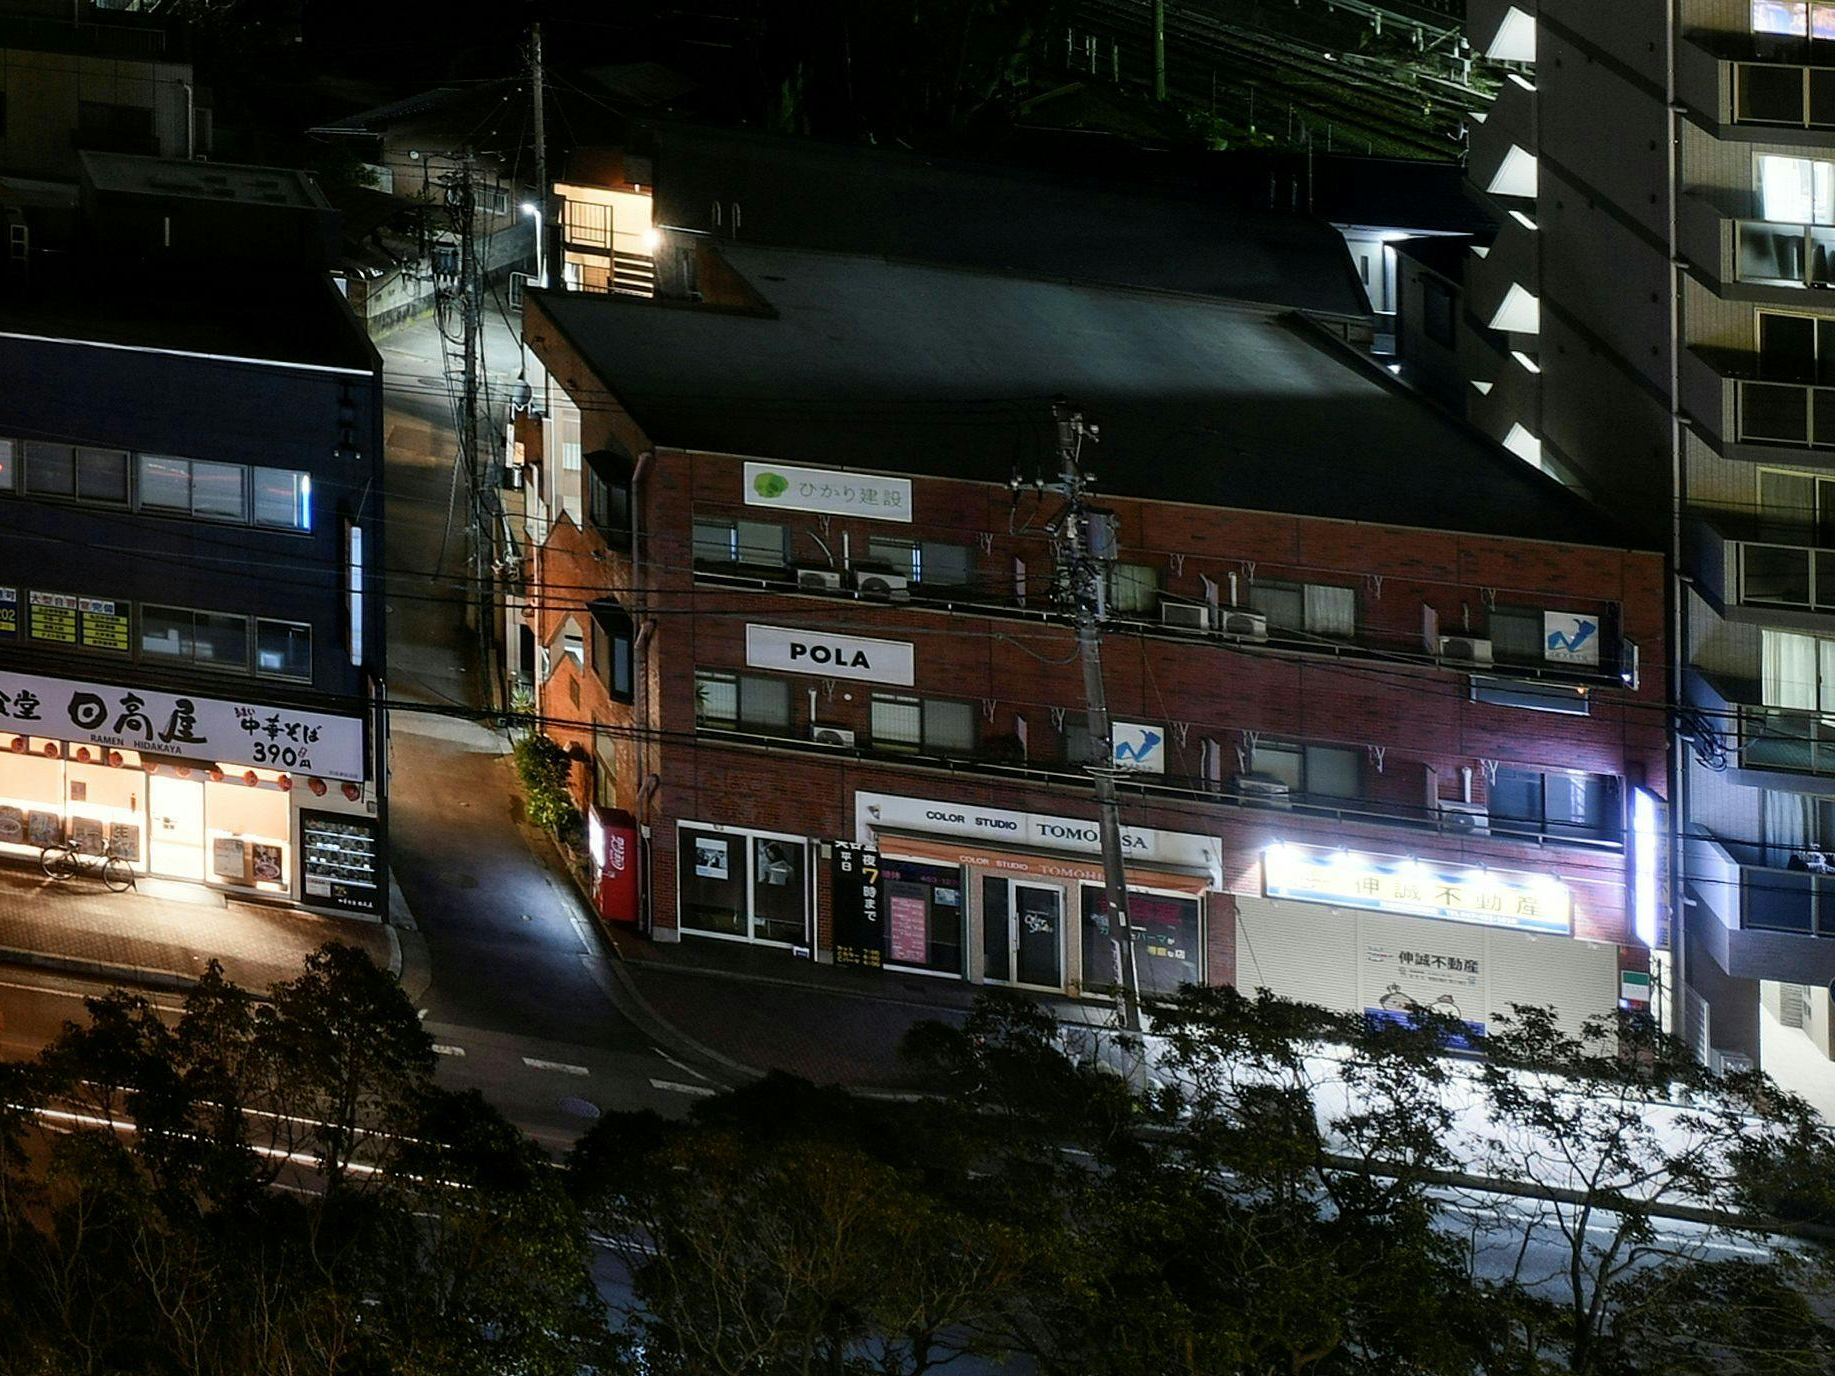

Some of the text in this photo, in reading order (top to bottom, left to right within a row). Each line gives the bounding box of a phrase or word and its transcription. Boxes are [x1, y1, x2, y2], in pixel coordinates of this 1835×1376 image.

[799, 482, 902, 508] ひかり建設
[790, 643, 870, 669] POLA
[68, 691, 207, 744] 日高屋
[241, 714, 322, 743] 中華そば
[90, 733, 182, 755] RAMEN HIDAKAYA
[253, 741, 312, 770] 390円
[926, 810, 1148, 850] COLOR STUDIO TOMOSA
[959, 855, 989, 866] COLOR
[996, 860, 1029, 871] STUDIO
[1398, 951, 1479, 974] 伸誠不動産
